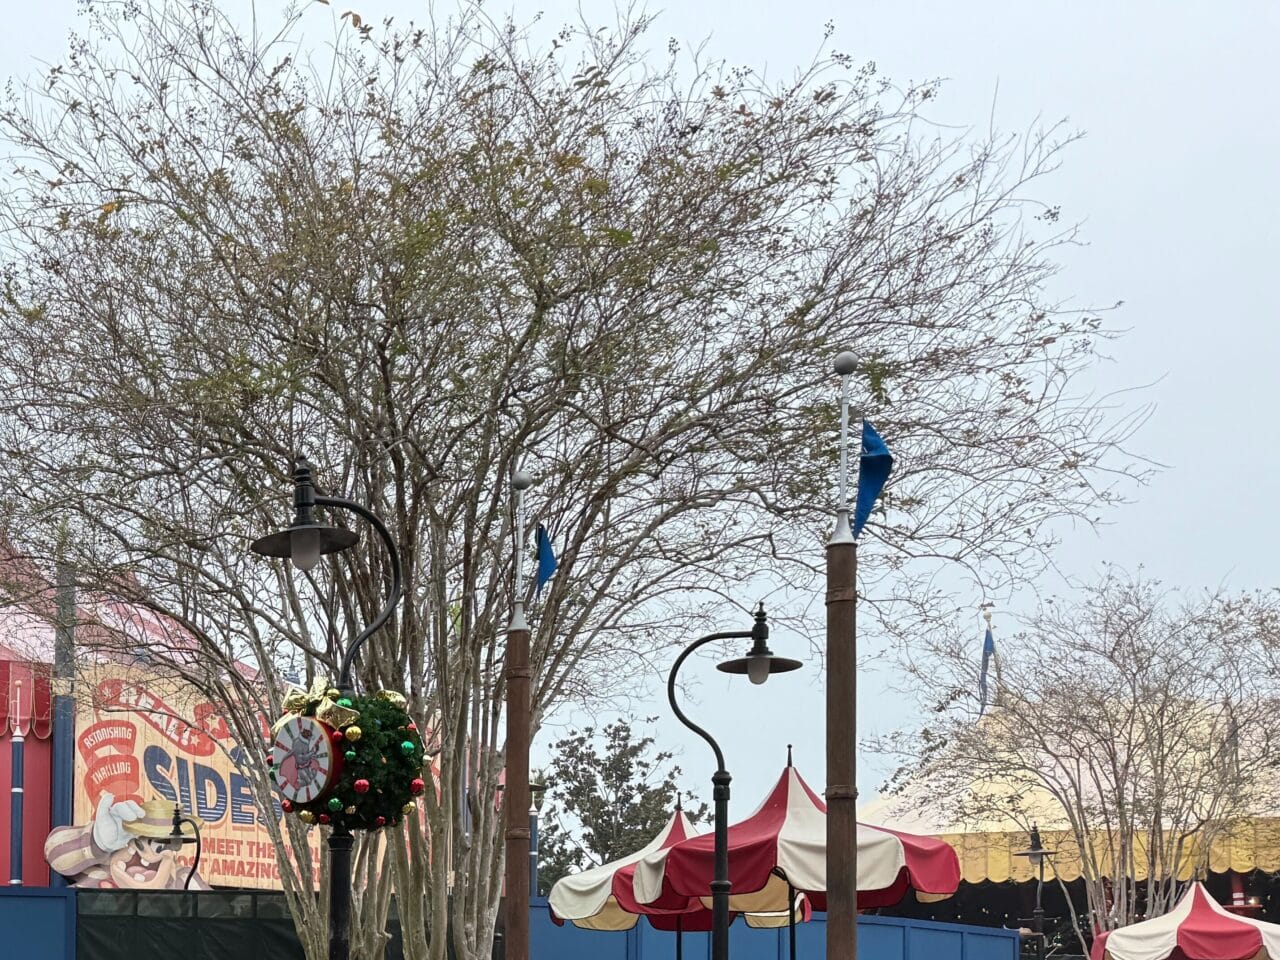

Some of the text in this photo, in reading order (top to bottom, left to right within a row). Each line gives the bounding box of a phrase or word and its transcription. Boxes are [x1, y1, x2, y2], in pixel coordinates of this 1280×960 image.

[83, 726, 133, 749] ASTONISHING
[91, 761, 131, 784] THRILLING
[202, 837, 243, 857] MEET
[246, 841, 275, 860] THE
[210, 856, 280, 880] AMAZING
